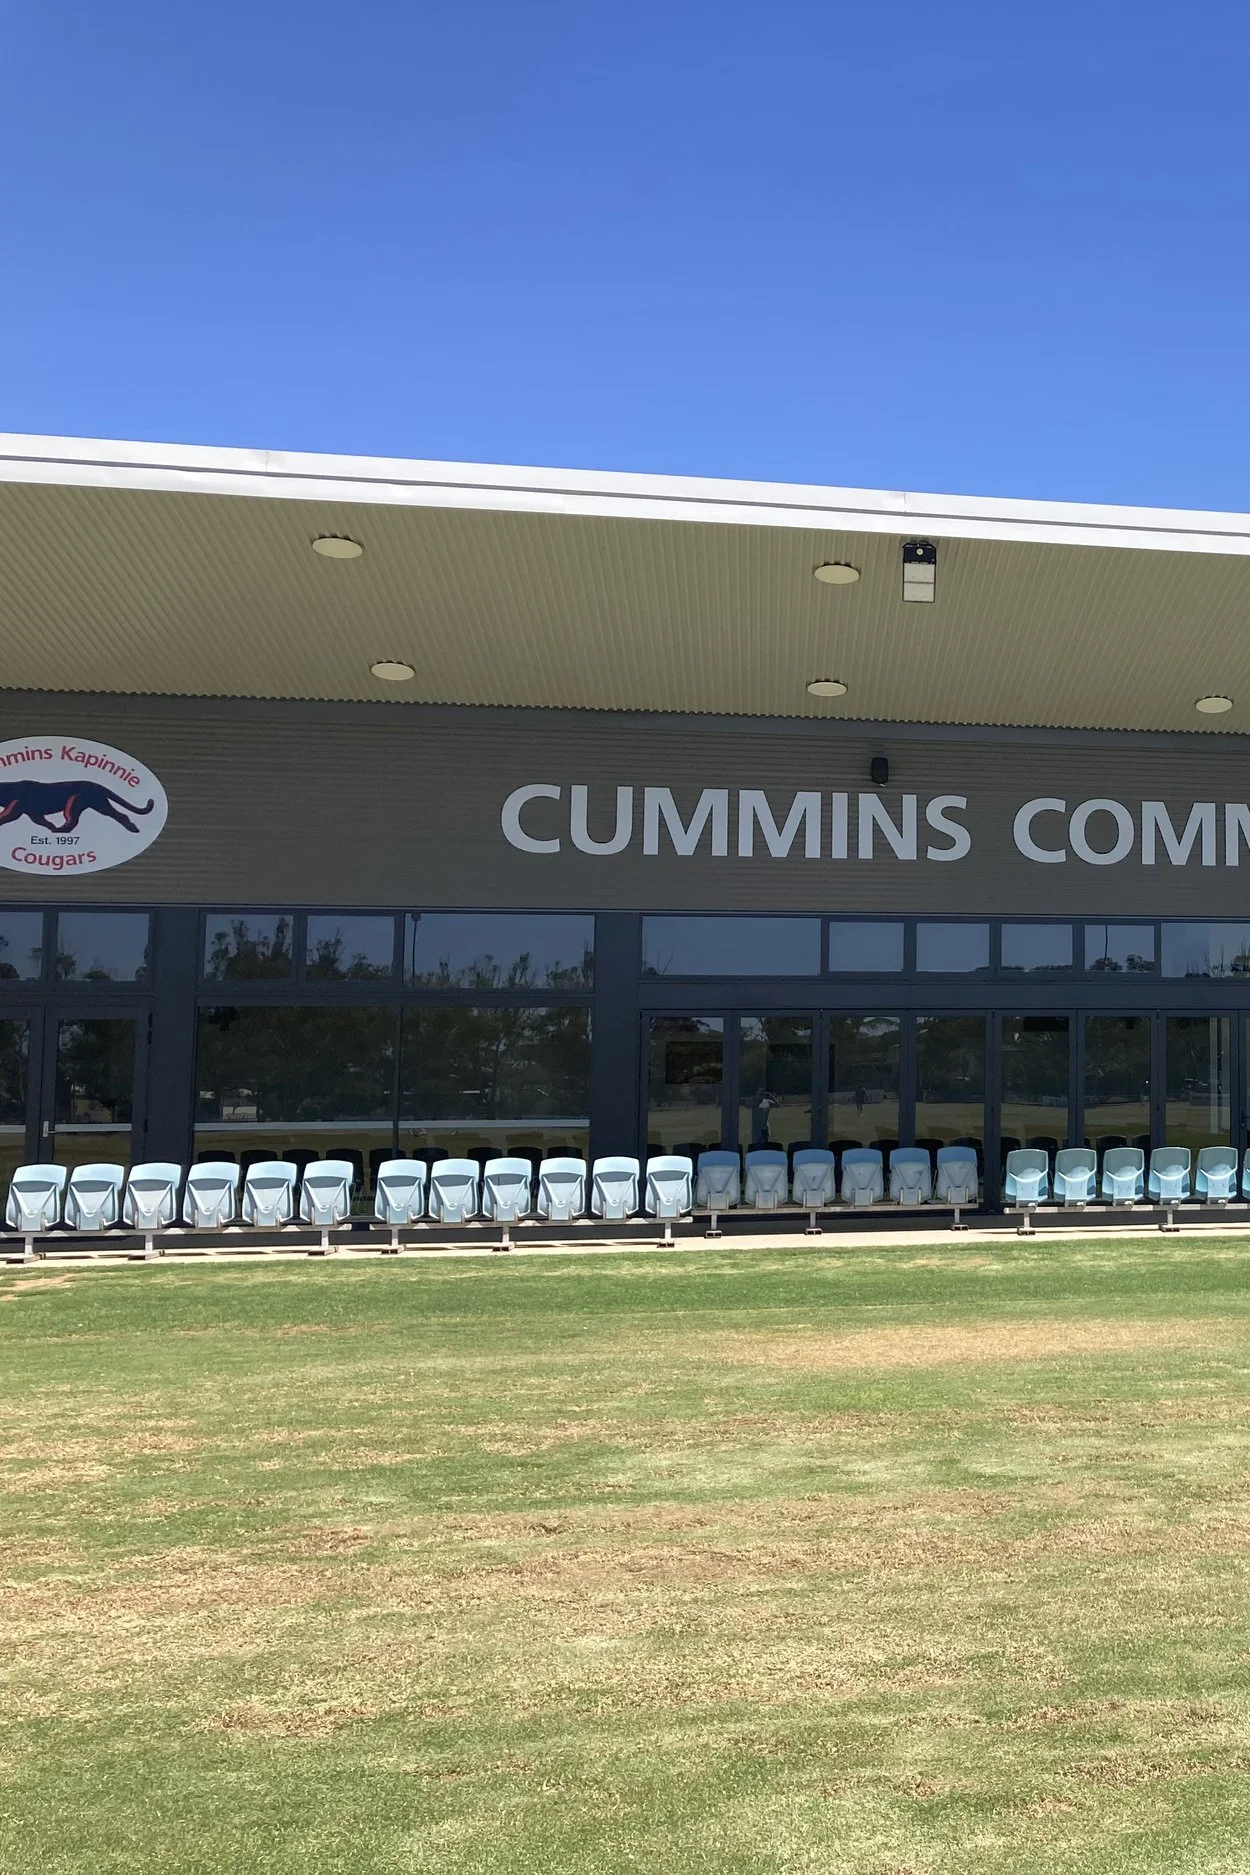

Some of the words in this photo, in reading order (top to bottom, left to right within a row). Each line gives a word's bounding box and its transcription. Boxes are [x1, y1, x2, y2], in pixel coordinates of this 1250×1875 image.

[60, 746, 141, 788] Kapinnie
[501, 784, 971, 863] CUMMINS
[30, 836, 51, 845] Est.
[56, 836, 80, 845] 1997
[11, 847, 97, 870] Cougars
